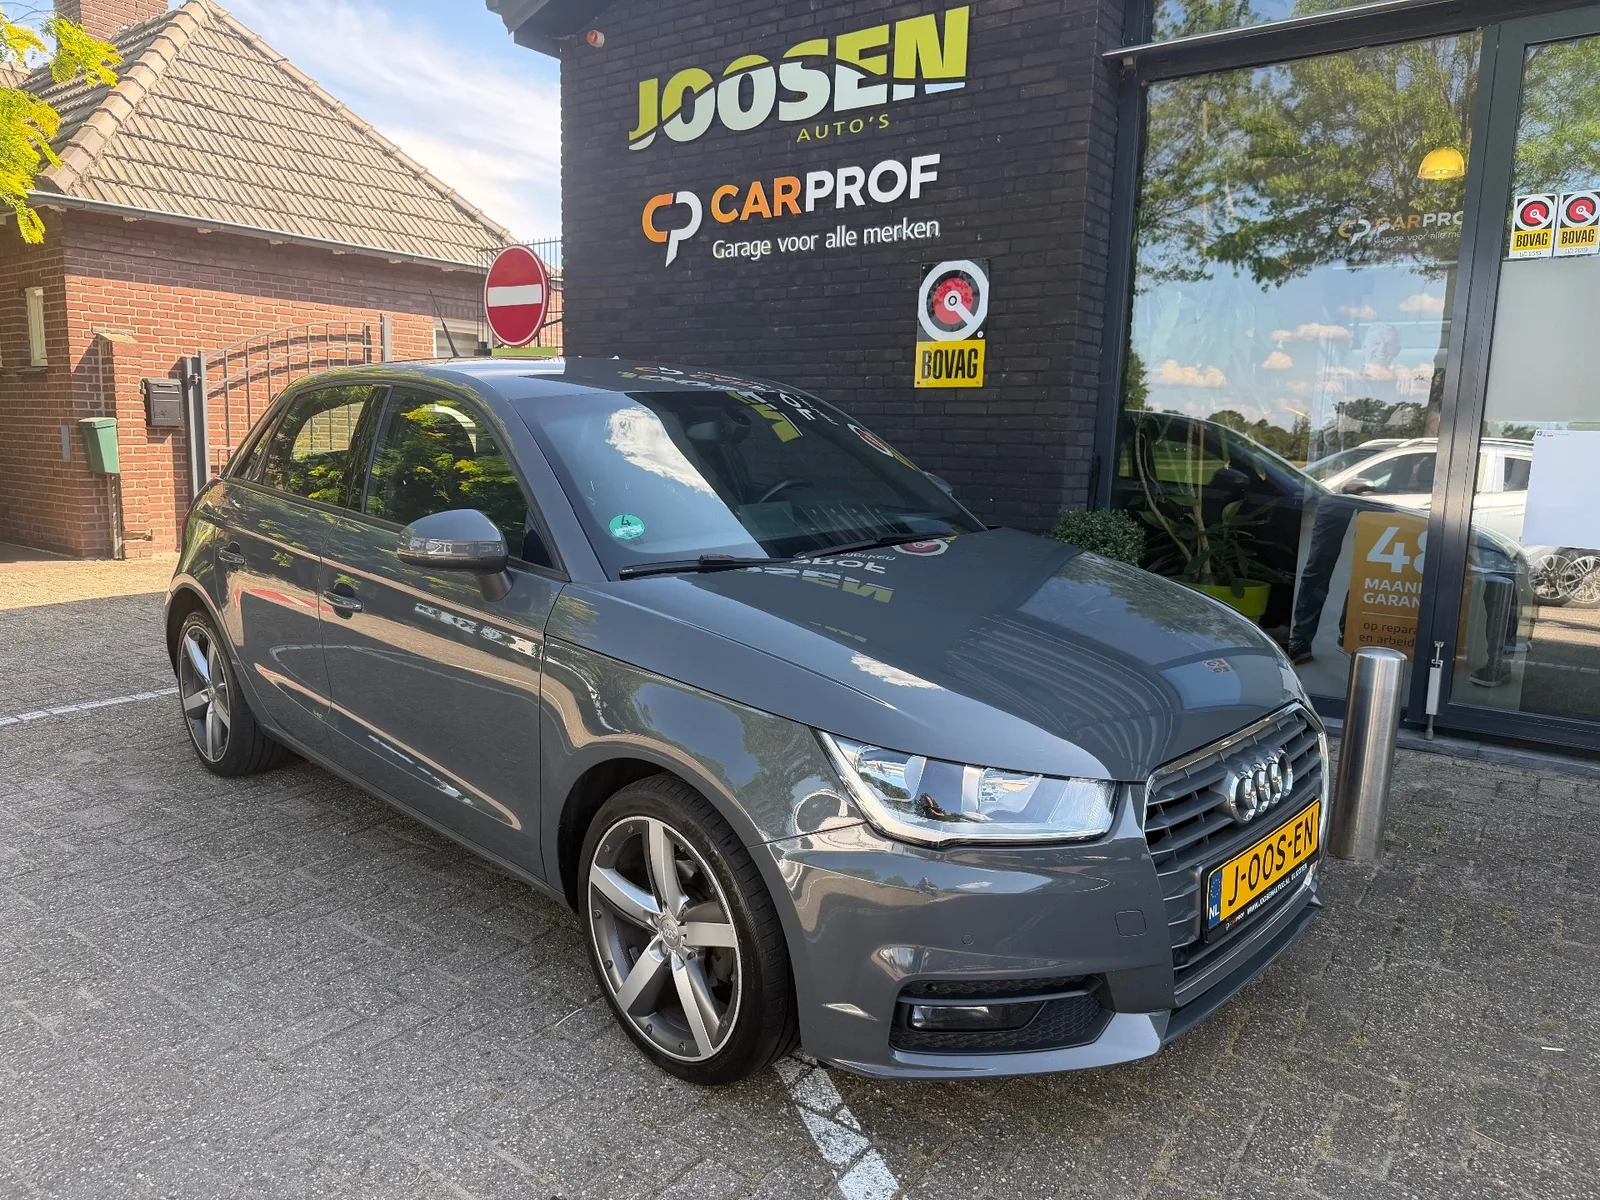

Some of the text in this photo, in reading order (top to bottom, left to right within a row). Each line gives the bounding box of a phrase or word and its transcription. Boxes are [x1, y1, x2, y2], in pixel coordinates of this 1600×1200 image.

[628, 5, 970, 151] JOOSEN
[796, 113, 891, 143] AUTO'S
[711, 153, 941, 224] CARPROF
[712, 217, 940, 261] Garage voor alle merken
[1430, 232, 1446, 240] alle
[1516, 232, 1548, 248] BOVAG
[1561, 229, 1595, 245] BOVAG
[921, 348, 979, 380] BOVAG
[1364, 577, 1423, 595] MAAN
[1363, 592, 1420, 609] GARAN
[1363, 622, 1378, 633] op
[1359, 634, 1373, 643] en
[1228, 811, 1315, 908] J-OOS-EN
[1208, 903, 1220, 920] NL
